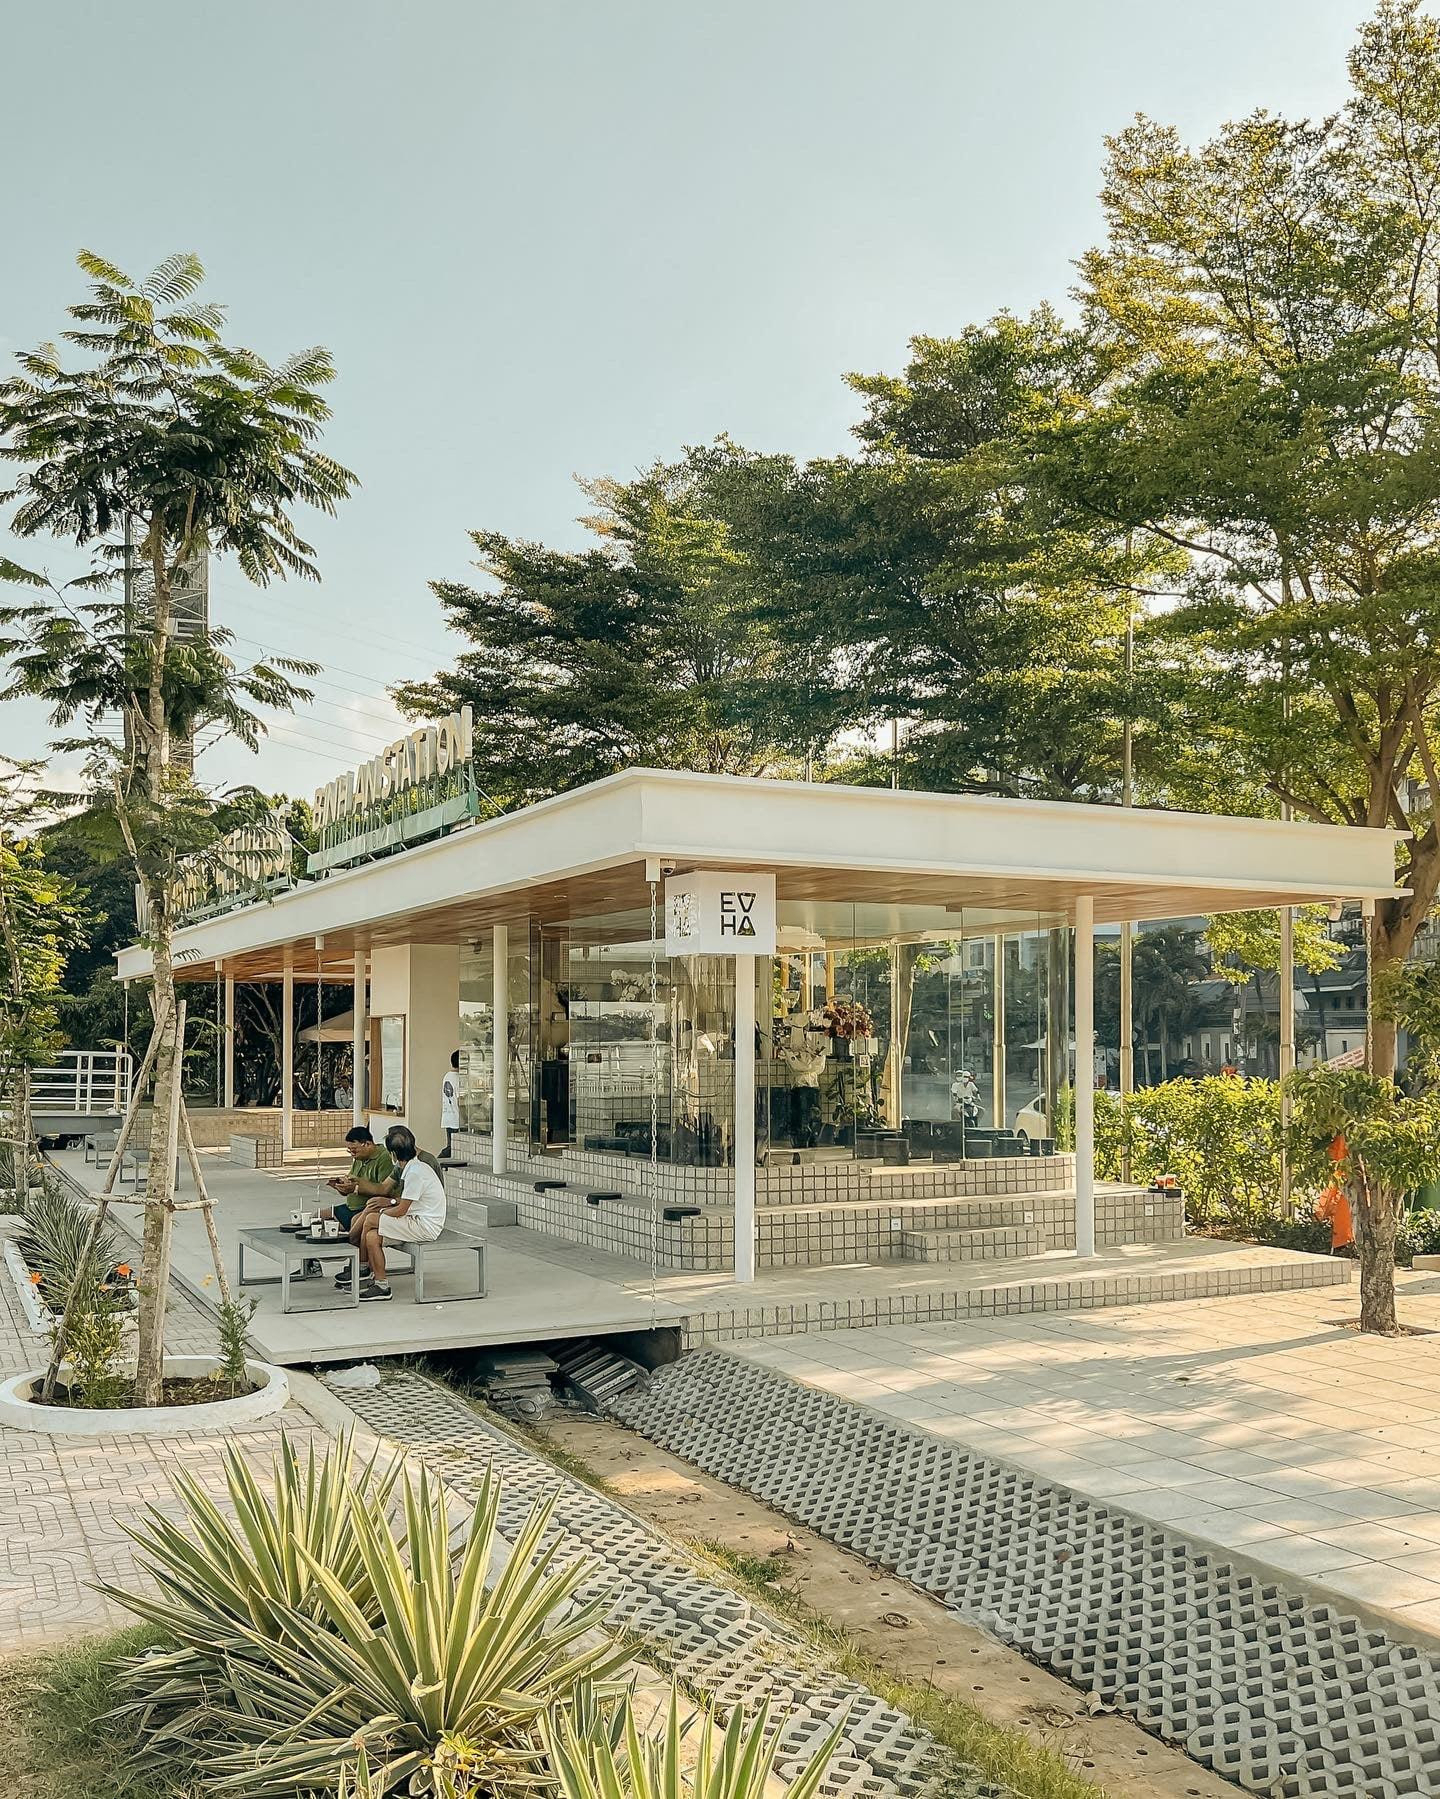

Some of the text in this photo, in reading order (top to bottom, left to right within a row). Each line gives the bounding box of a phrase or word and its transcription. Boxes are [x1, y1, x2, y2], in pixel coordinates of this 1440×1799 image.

[381, 705, 473, 800] STATION
[720, 892, 757, 913] EV
[720, 915, 757, 936] HA
